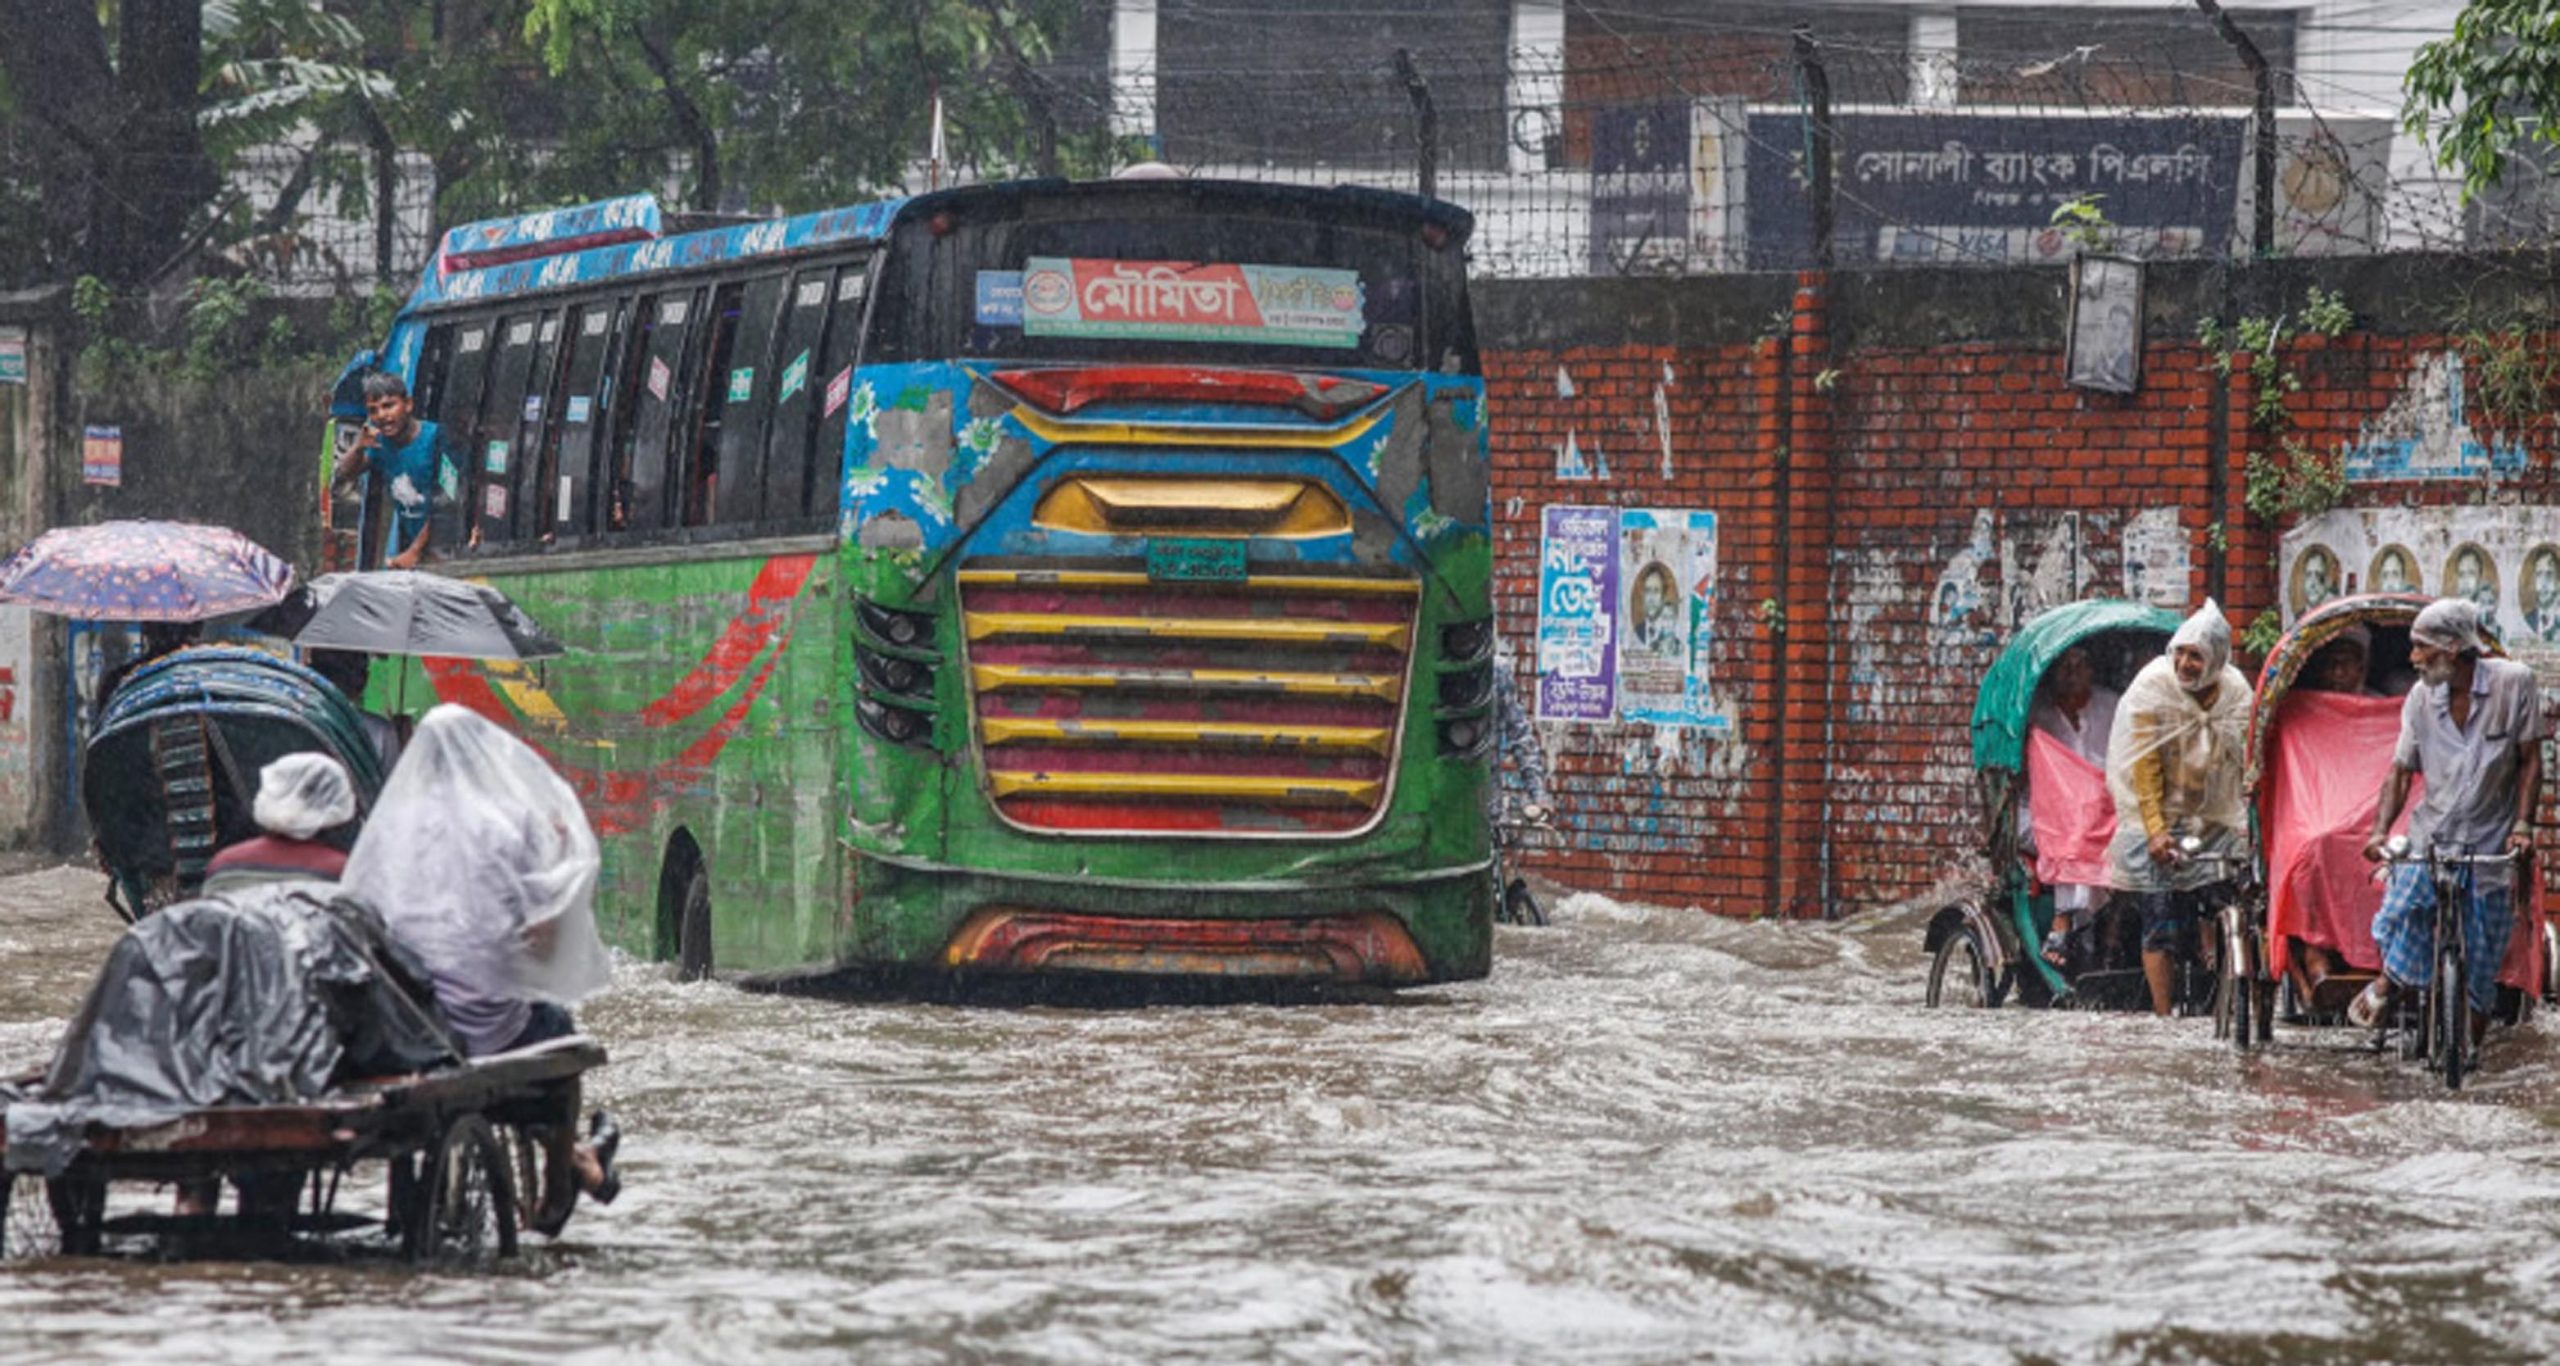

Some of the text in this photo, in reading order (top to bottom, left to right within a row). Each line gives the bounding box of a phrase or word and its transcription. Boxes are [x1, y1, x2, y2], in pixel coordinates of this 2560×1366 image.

[1855, 139, 1976, 183] সোনালী
[1984, 151, 2080, 186] ব্যাংক
[1084, 262, 1241, 321] মৌমিতা
